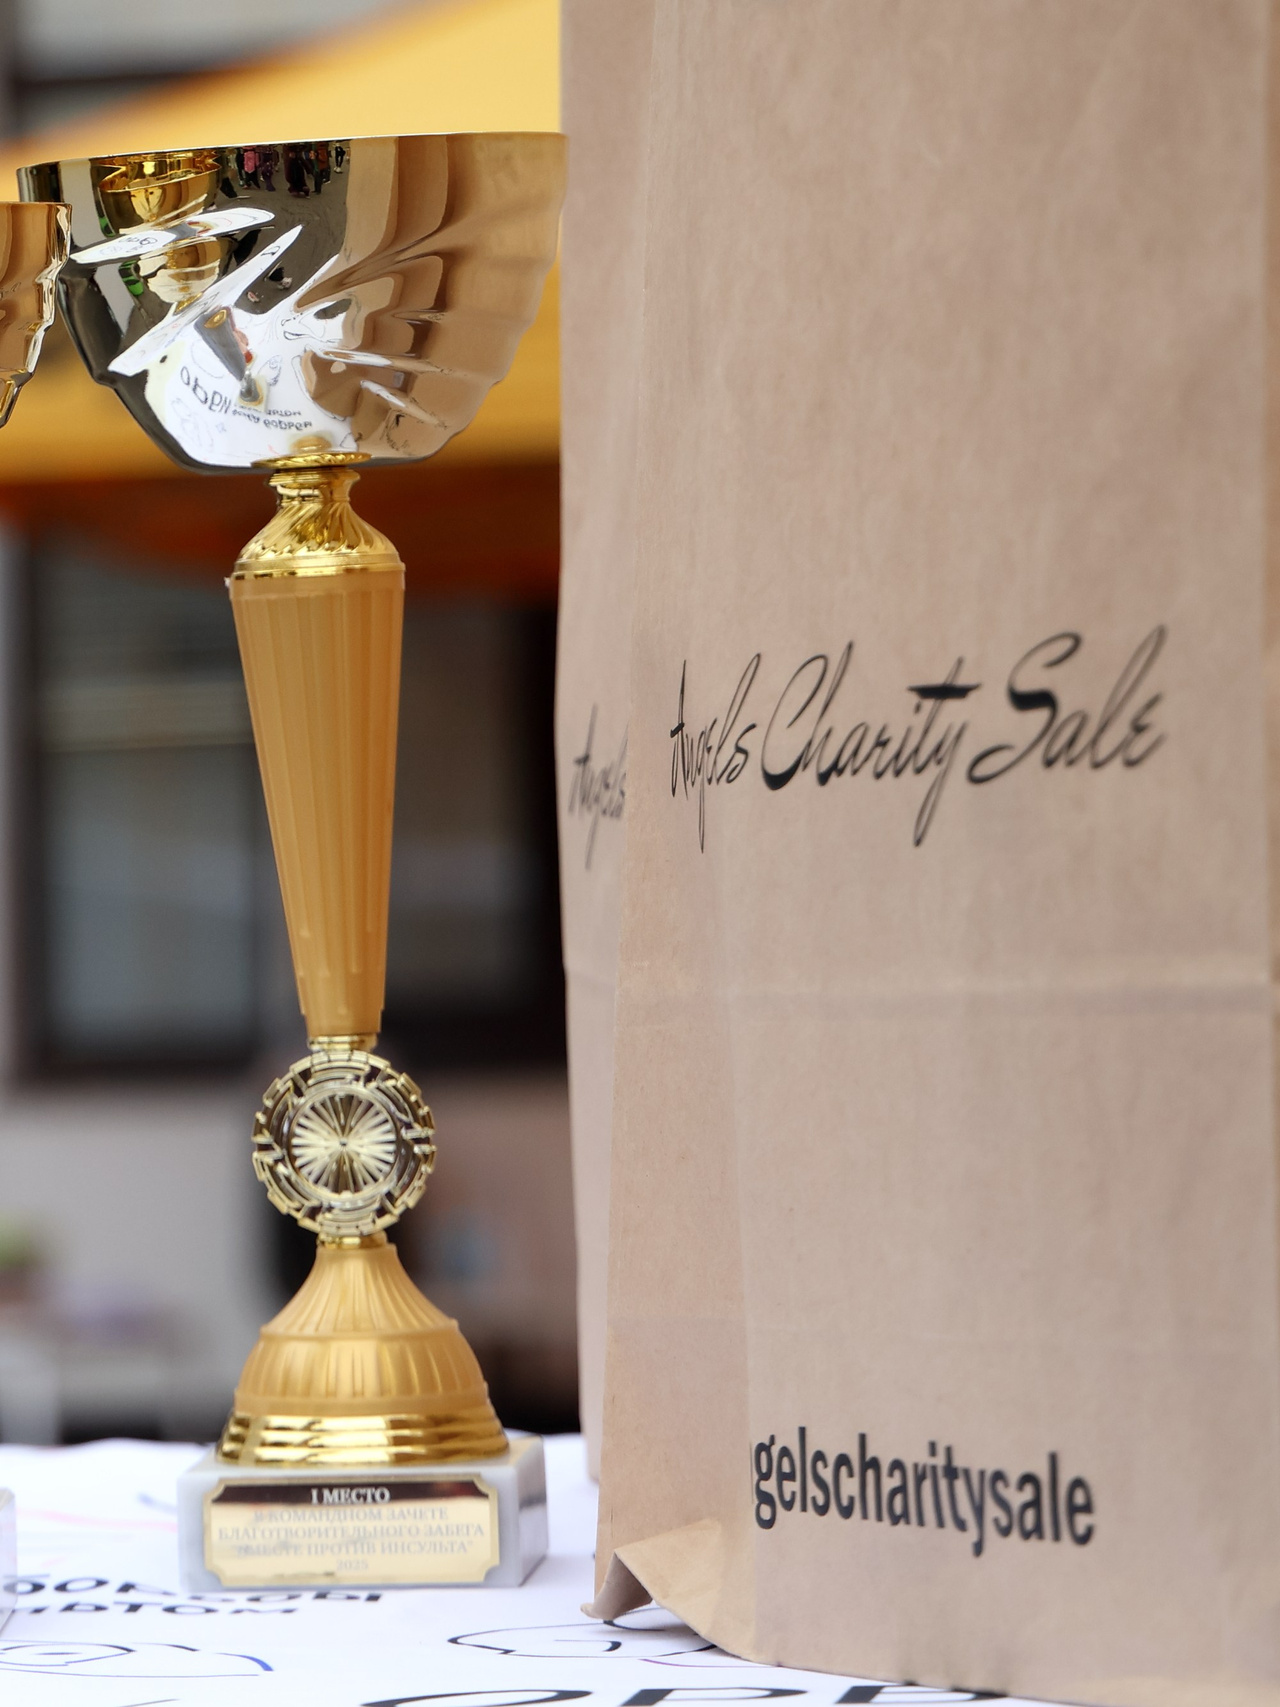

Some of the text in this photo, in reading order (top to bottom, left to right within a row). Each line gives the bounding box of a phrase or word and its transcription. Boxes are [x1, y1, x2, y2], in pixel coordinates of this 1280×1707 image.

[669, 624, 1168, 854] Angels Charity Sale
[321, 1486, 391, 1505] МЕСТО
[749, 1425, 1096, 1559] gelscharitysale
[268, 1508, 383, 1525] КОМАНДНОМ
[386, 1506, 449, 1522] ЗАЧЕТЕ
[218, 1523, 485, 1542] БЛАГОТВОРИТЕЛЬНОГО ЗАБЕГА
[307, 1541, 376, 1557] ПРОТИВ
[380, 1540, 474, 1556] ИНСУЛЬТА"
[335, 1559, 369, 1573] 2025
